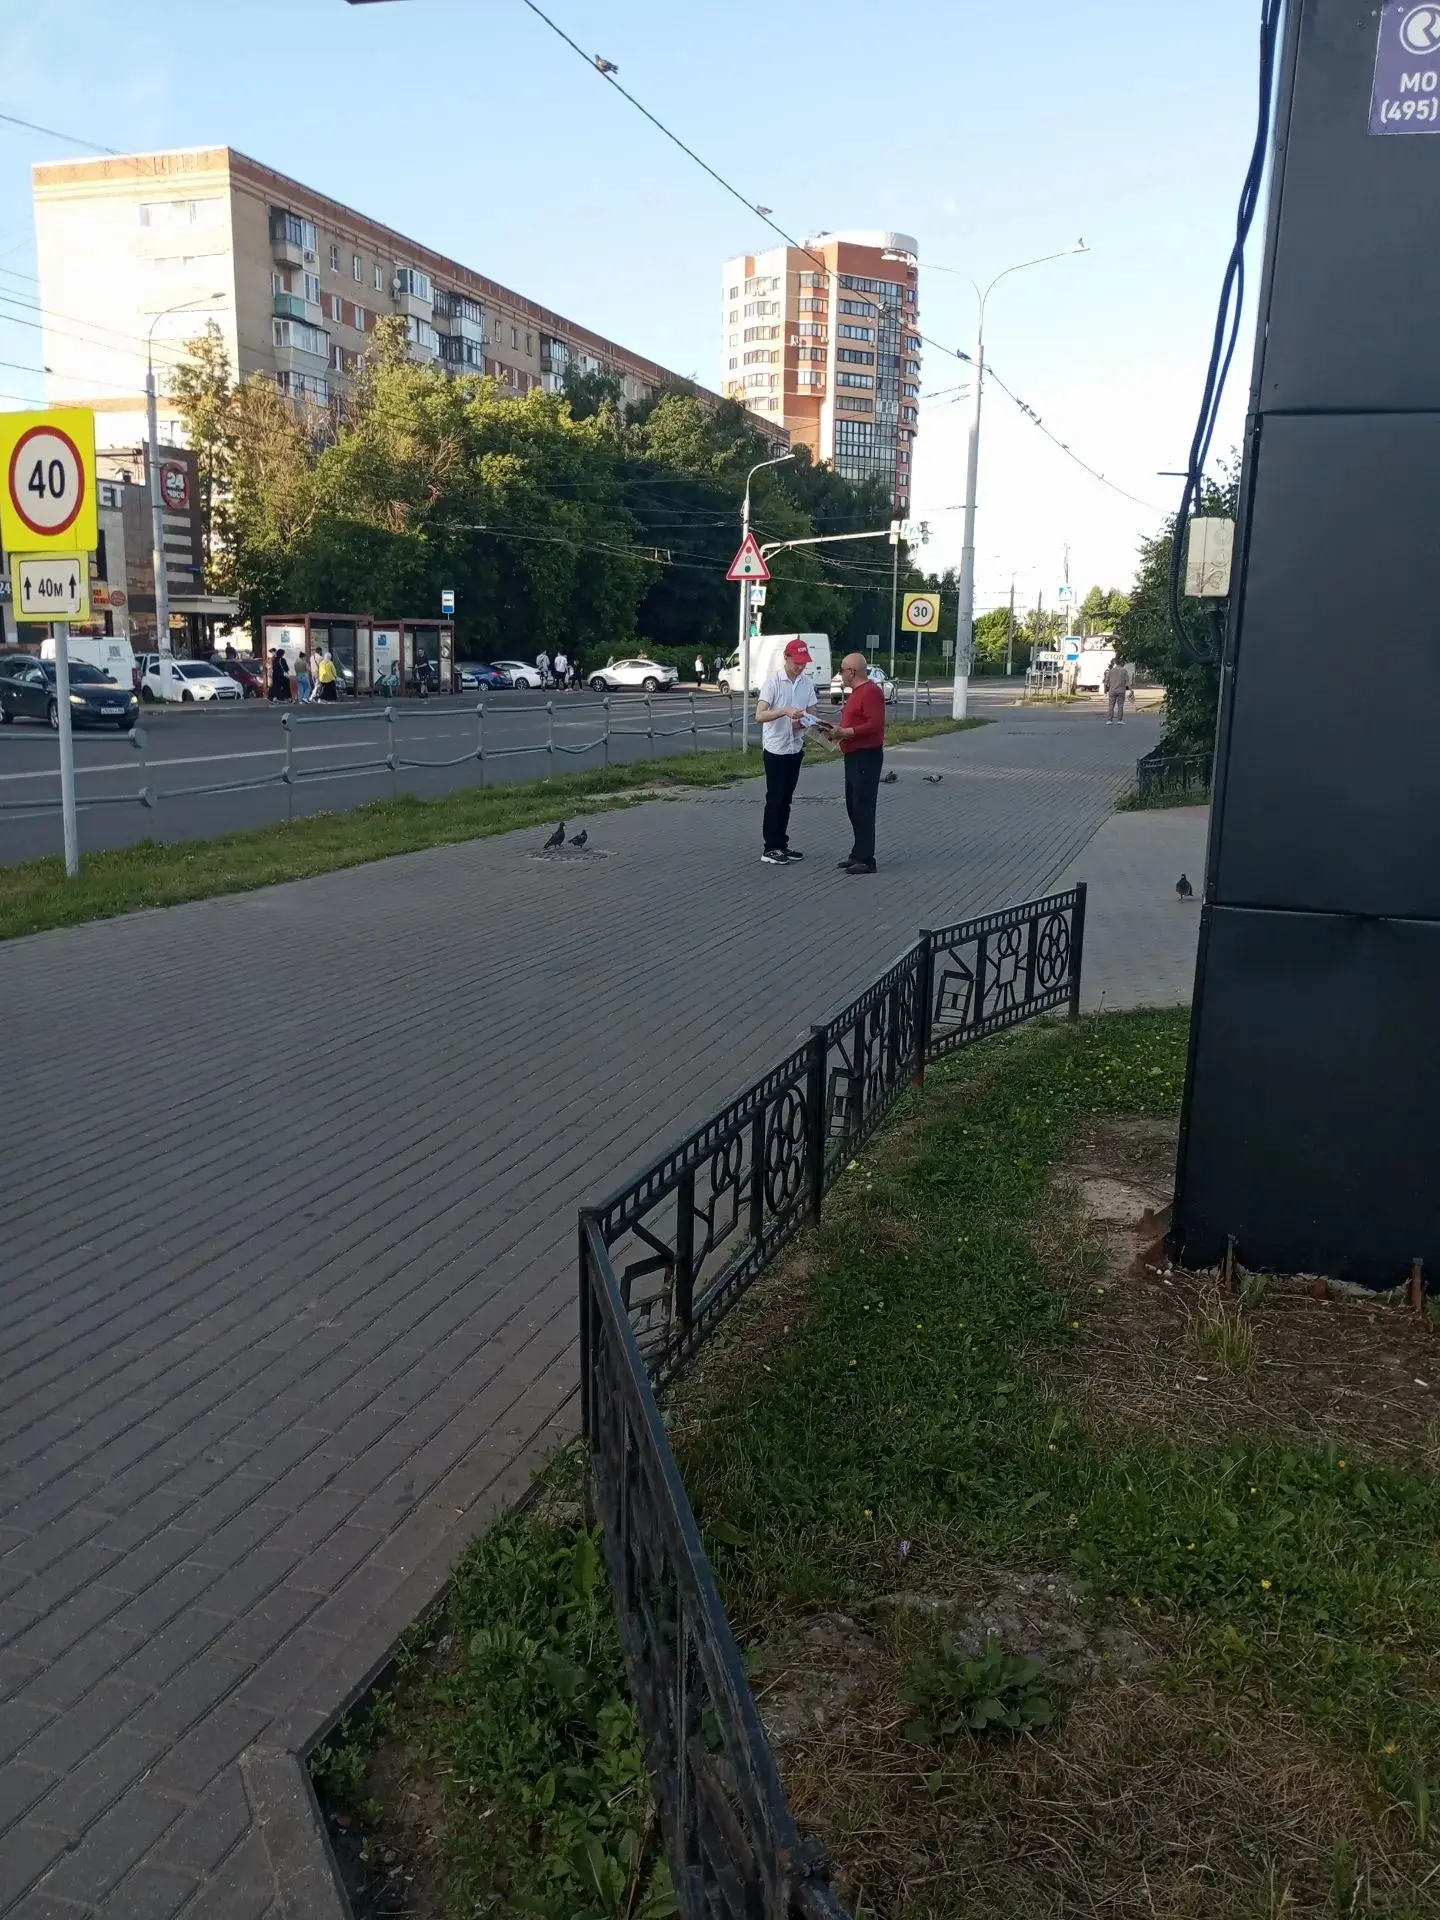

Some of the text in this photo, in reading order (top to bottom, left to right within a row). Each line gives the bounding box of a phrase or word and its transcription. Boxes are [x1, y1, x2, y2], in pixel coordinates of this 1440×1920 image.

[1380, 97, 1438, 124] (495)
[28, 459, 65, 498] 40
[167, 472, 185, 489] 24
[913, 606, 928, 618] 30
